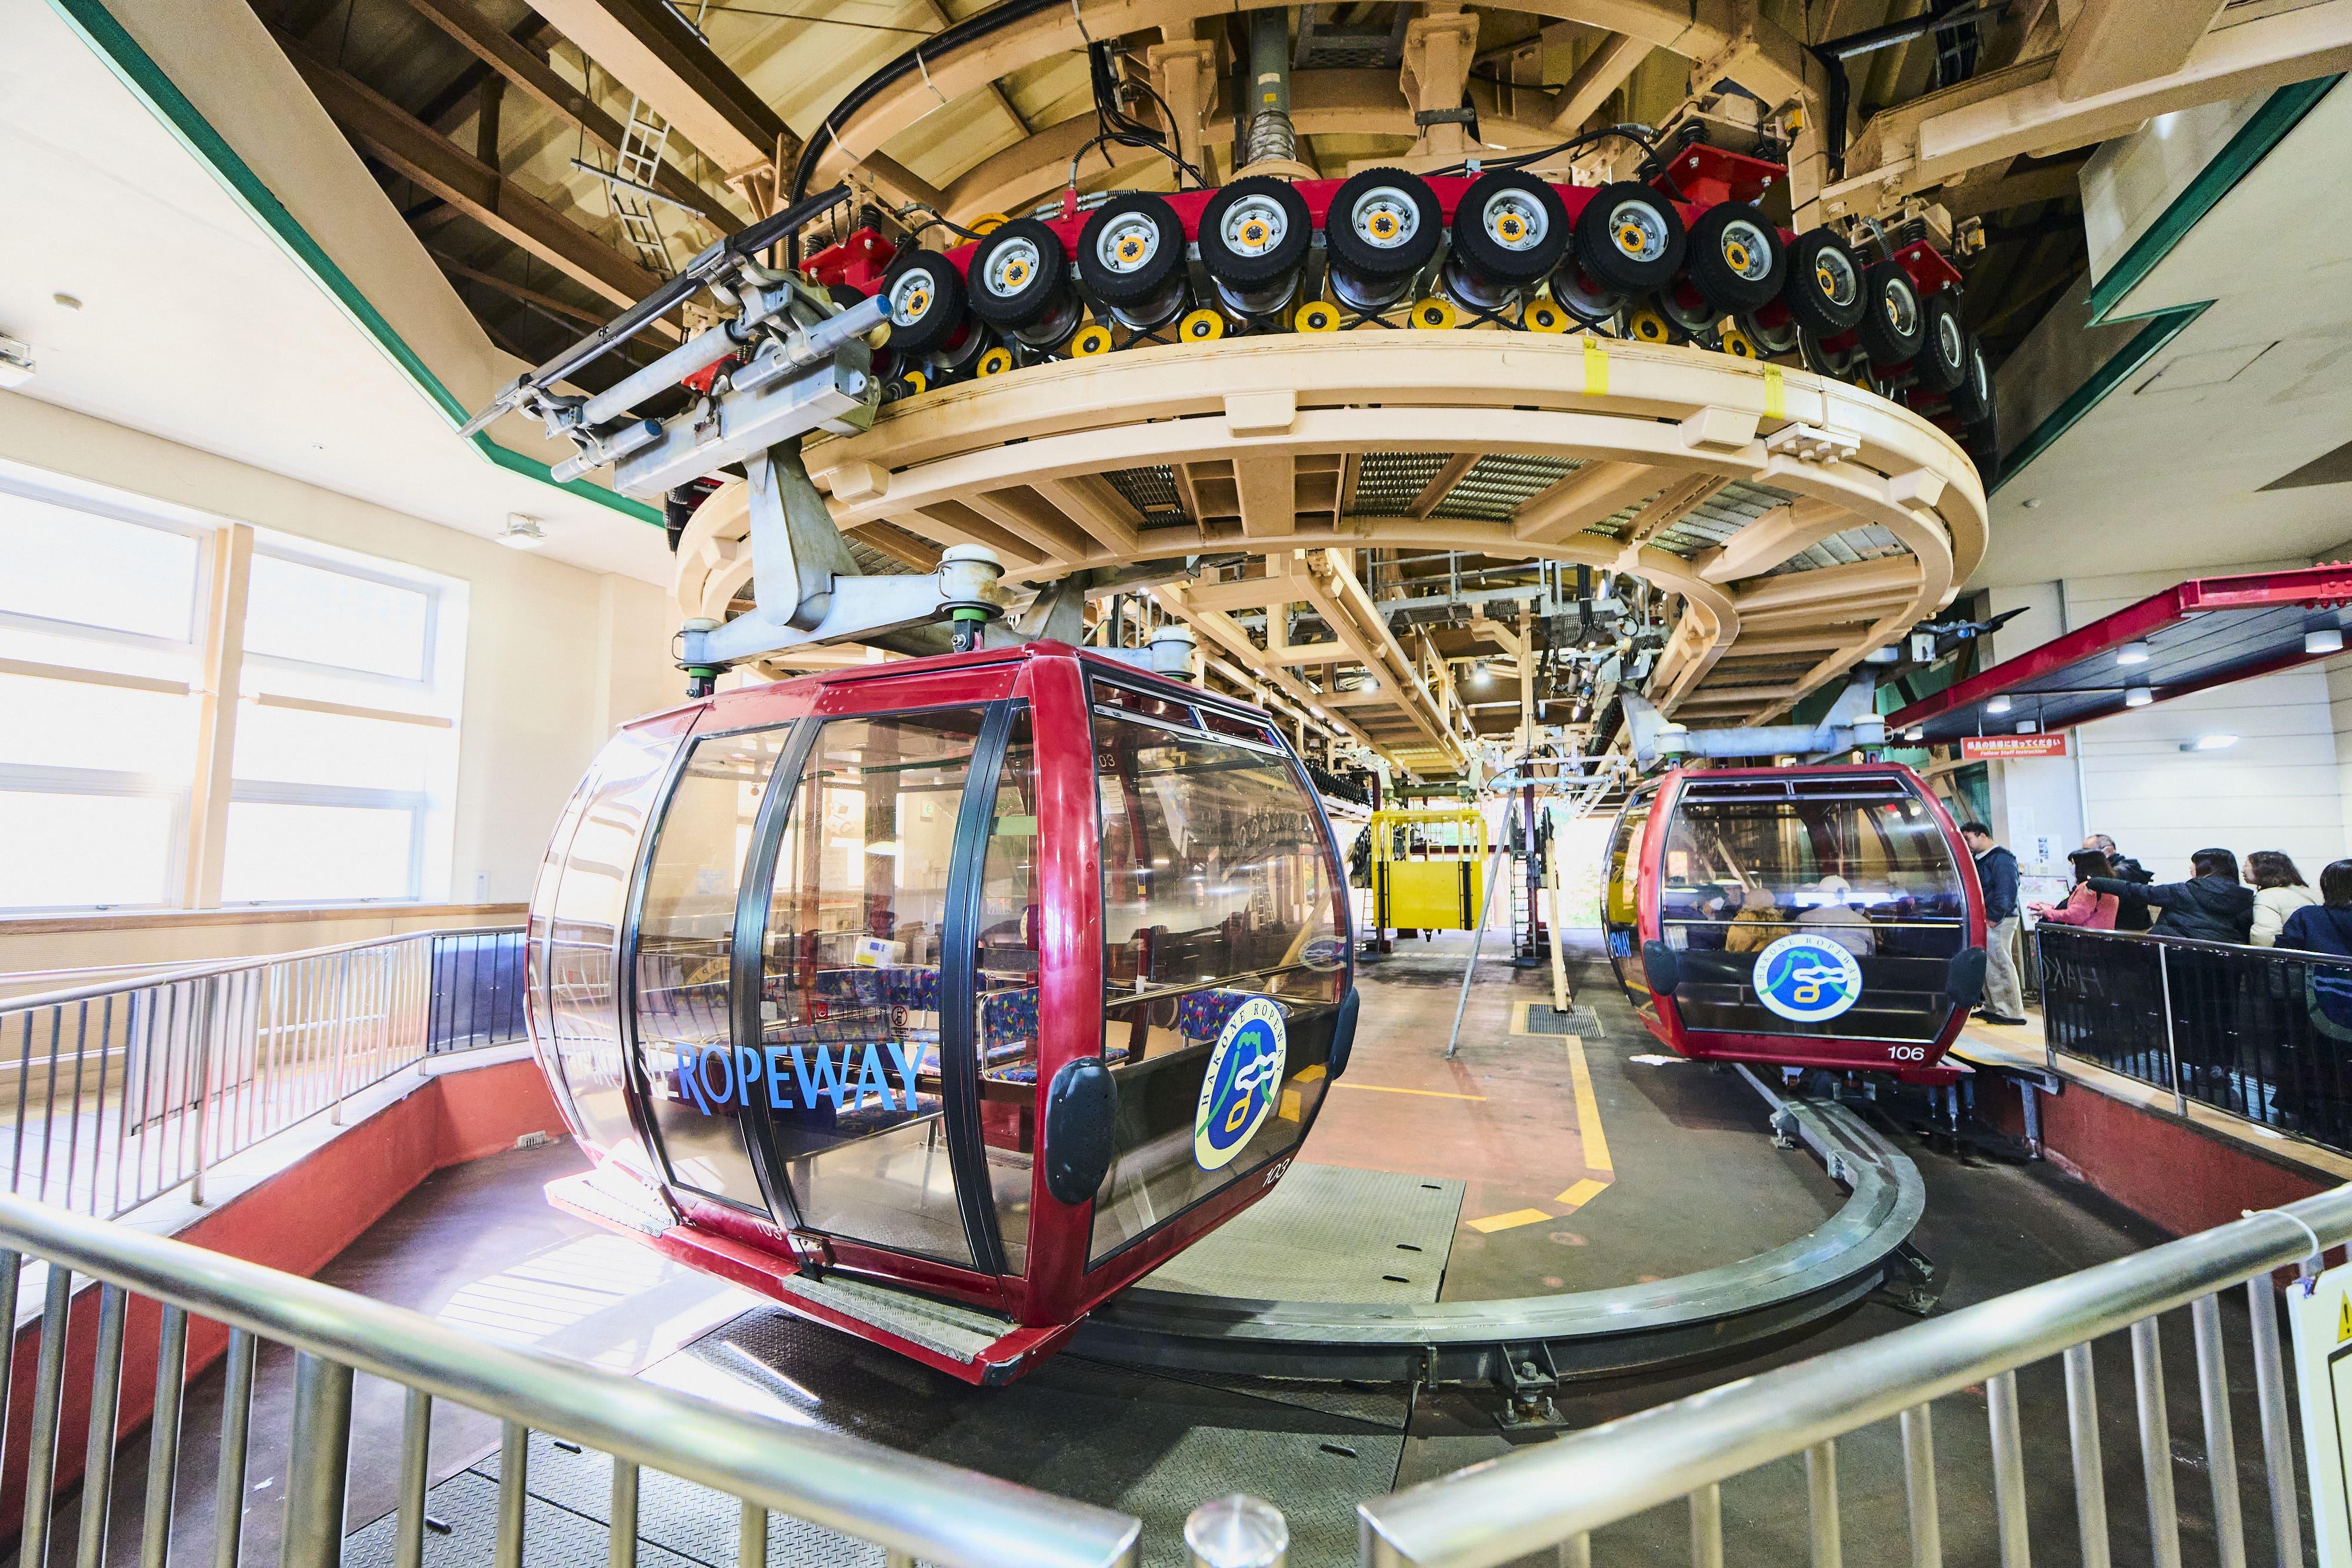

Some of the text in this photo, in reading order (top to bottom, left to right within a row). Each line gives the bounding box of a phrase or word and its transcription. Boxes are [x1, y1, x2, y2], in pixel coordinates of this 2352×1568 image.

[1098, 754, 1115, 767] 03
[1757, 938, 1858, 982] HAKONE ROPEWAY
[1202, 1003, 1284, 1106] HAKONE ROPEWAY
[1887, 1046, 1925, 1061] 106
[675, 1042, 928, 1116] ROPEWAY
[1262, 1158, 1290, 1188] 103
